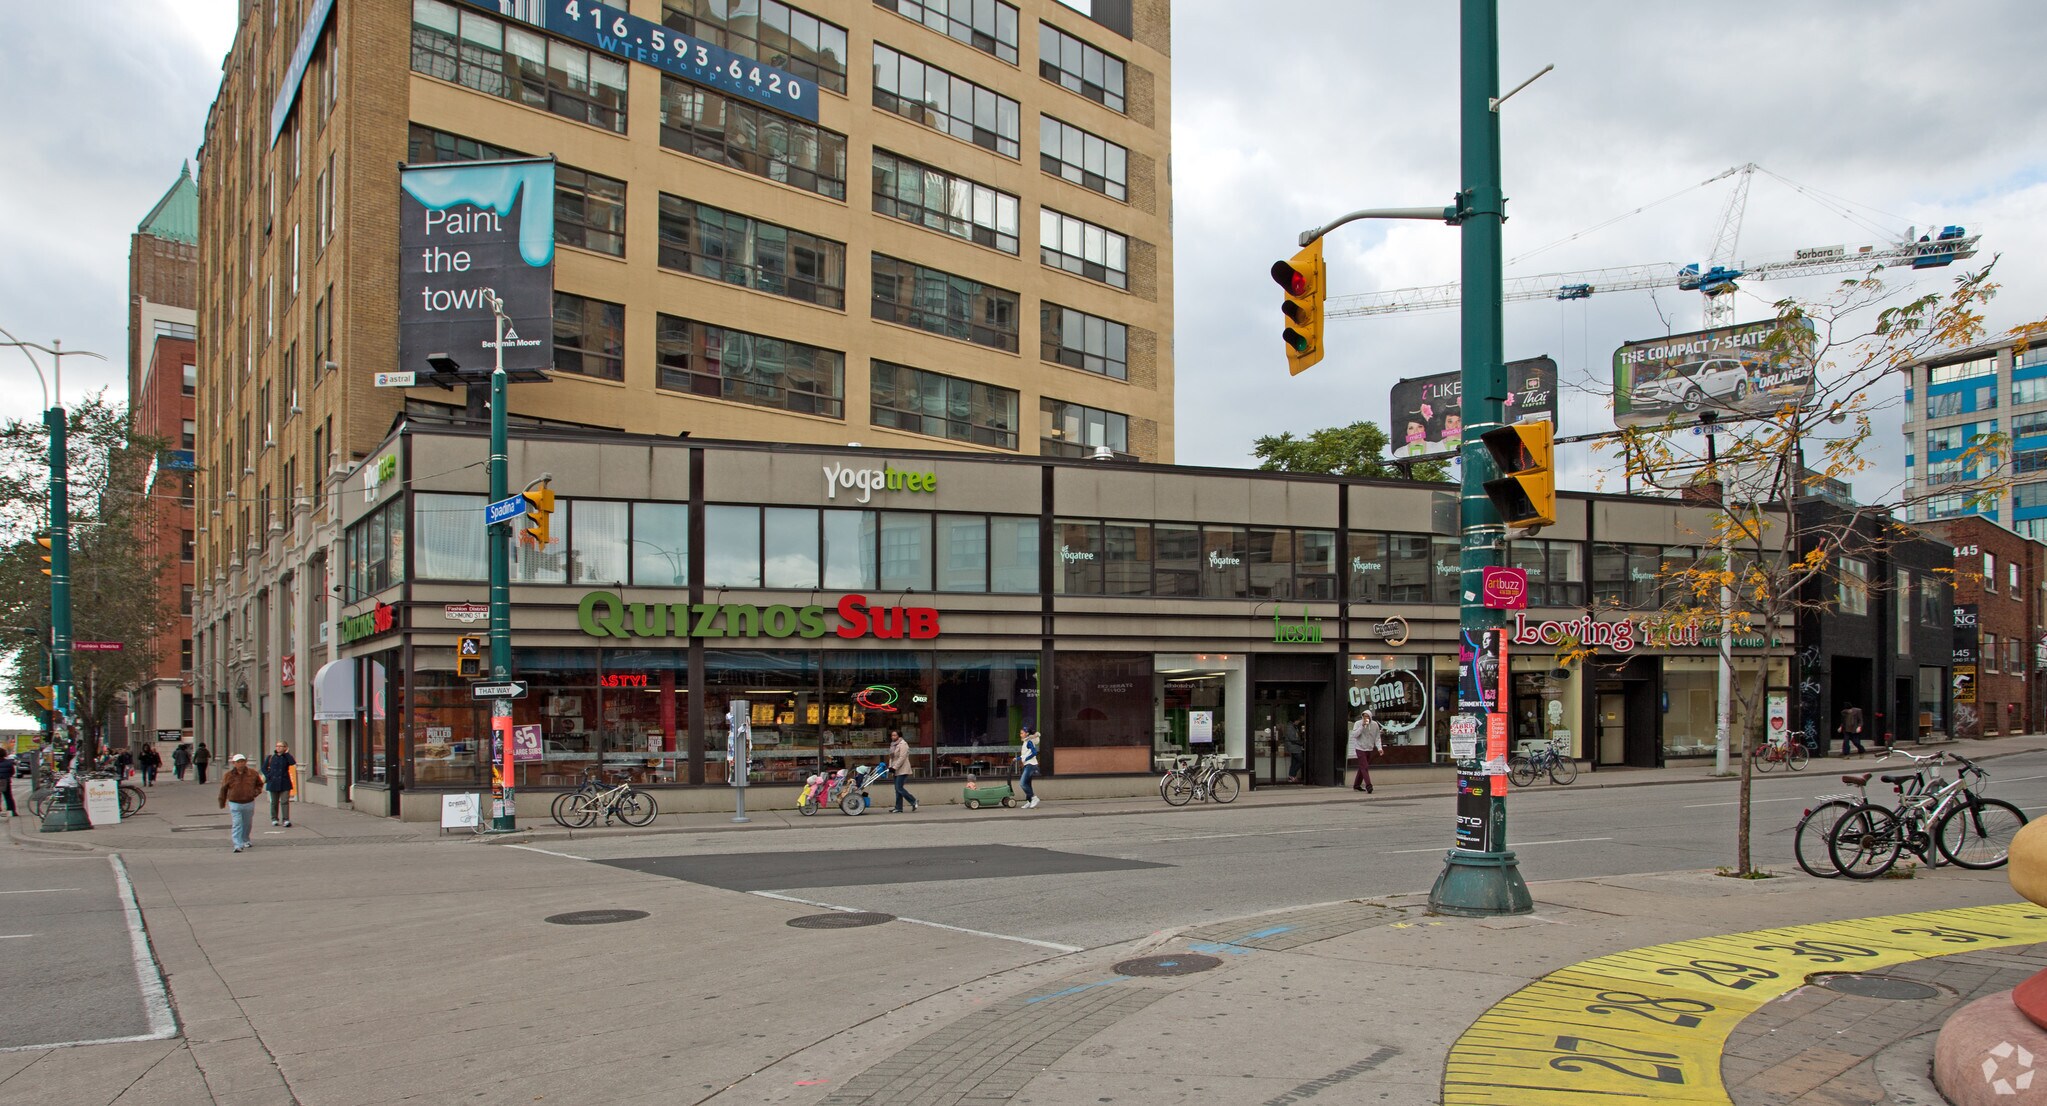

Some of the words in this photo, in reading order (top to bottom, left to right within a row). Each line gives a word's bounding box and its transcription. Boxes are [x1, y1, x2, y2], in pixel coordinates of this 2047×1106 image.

[565, 0, 801, 100] 416.593.6420
[597, 32, 771, 98] WTFgroup.com
[425, 206, 502, 236] Paint
[422, 246, 471, 273] the
[1796, 248, 1833, 260] Sorbara
[422, 286, 496, 312] town
[482, 340, 515, 349] Benmin
[517, 339, 541, 347] Moore
[1620, 350, 1646, 365] THE
[1648, 339, 1709, 361] COMPACT
[389, 374, 411, 383] astral
[1759, 365, 1813, 389] ORLANDO
[1433, 381, 1462, 398] LIKE
[1703, 424, 1724, 434] CBS
[823, 461, 937, 504] Yogatree
[490, 501, 515, 520] Spadina
[1953, 545, 1978, 557] 445
[1436, 564, 1461, 577] Yogatre
[1488, 578, 1519, 590] artbuzz
[578, 591, 831, 639] Quiznos
[1273, 605, 1324, 644] freshii
[1514, 612, 1634, 652] Loving
[1349, 680, 1405, 707] Crema
[1369, 700, 1394, 711] COFFEE
[427, 730, 452, 738] PULLED
[427, 737, 446, 745] PORK
[515, 726, 538, 749] $5
[1891, 925, 2012, 943] 31
[1754, 940, 1880, 963] 30
[1656, 960, 1780, 991] 29
[1585, 991, 1716, 1028] 28
[1549, 1035, 1685, 1085] 27
